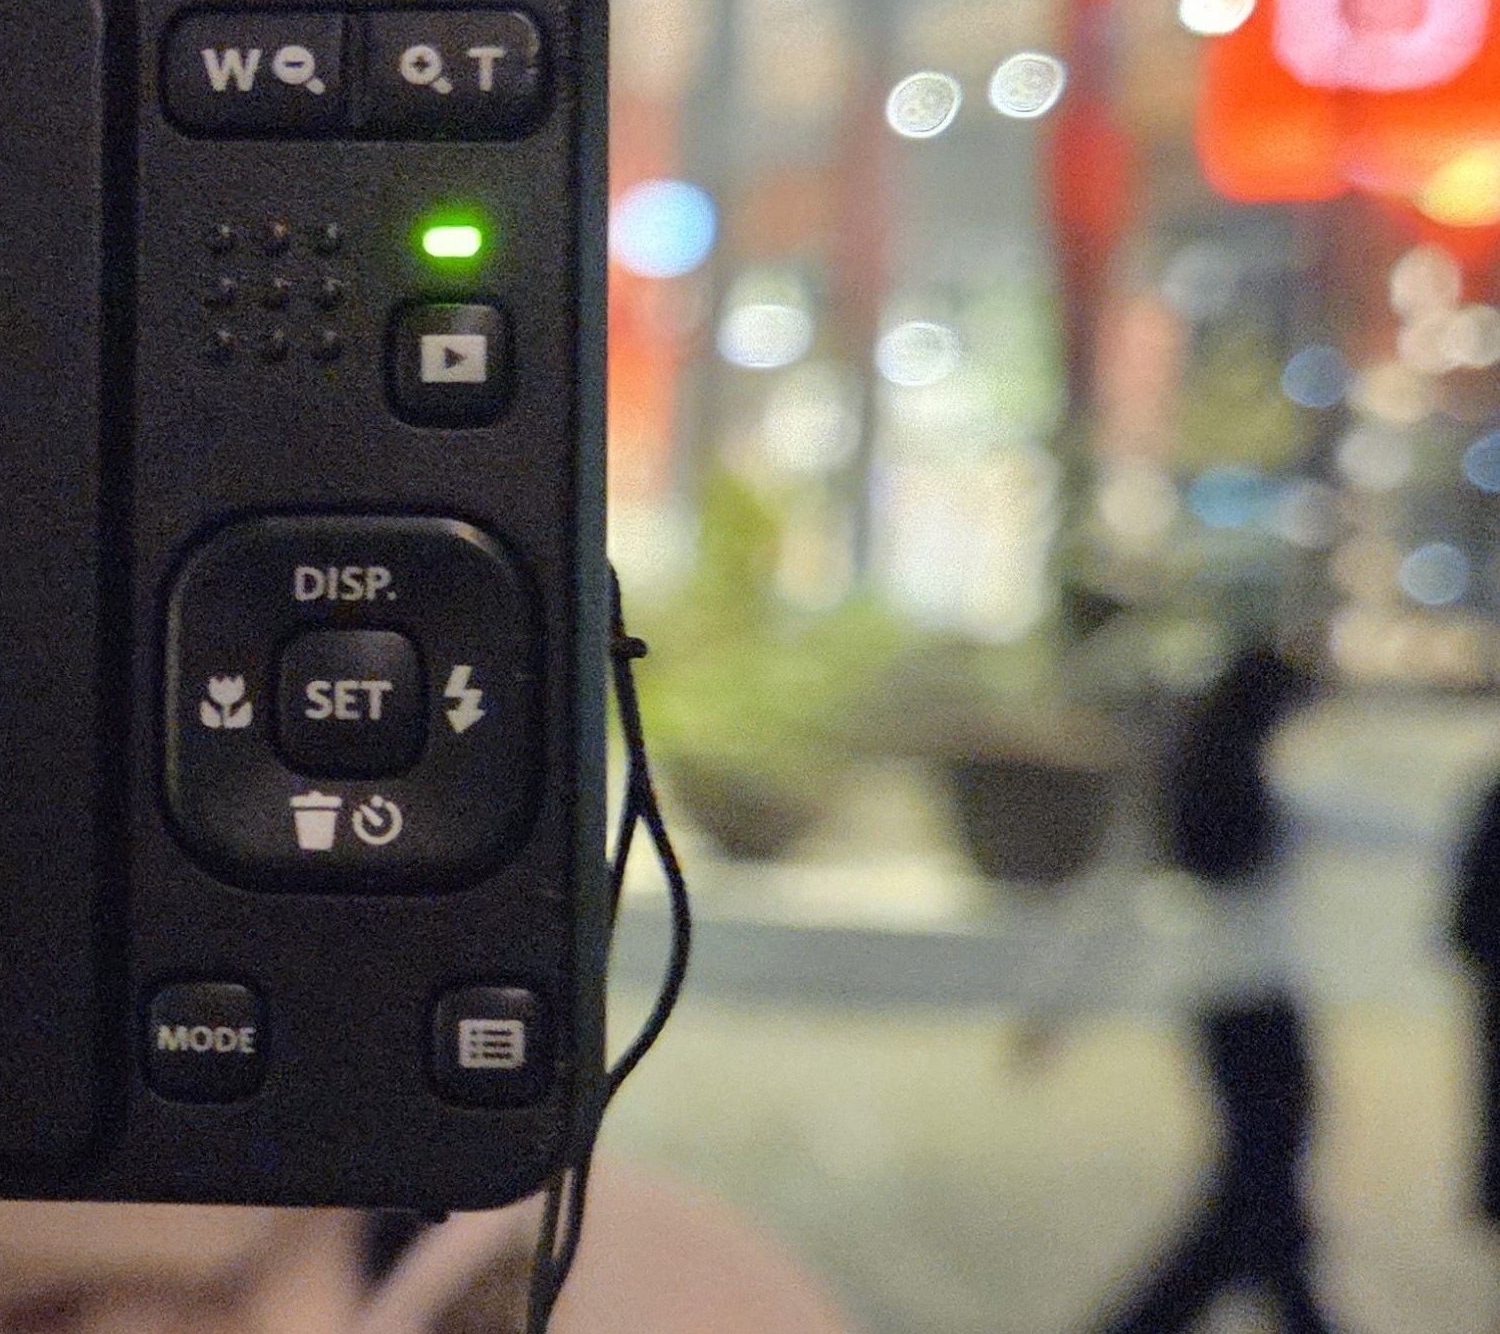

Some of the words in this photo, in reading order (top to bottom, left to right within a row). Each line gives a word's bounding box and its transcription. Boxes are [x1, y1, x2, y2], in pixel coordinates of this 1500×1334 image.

[202, 47, 260, 92] W
[468, 46, 505, 92] T
[295, 565, 397, 603] DISP.
[304, 679, 394, 721] SET
[156, 1024, 256, 1056] MODE
